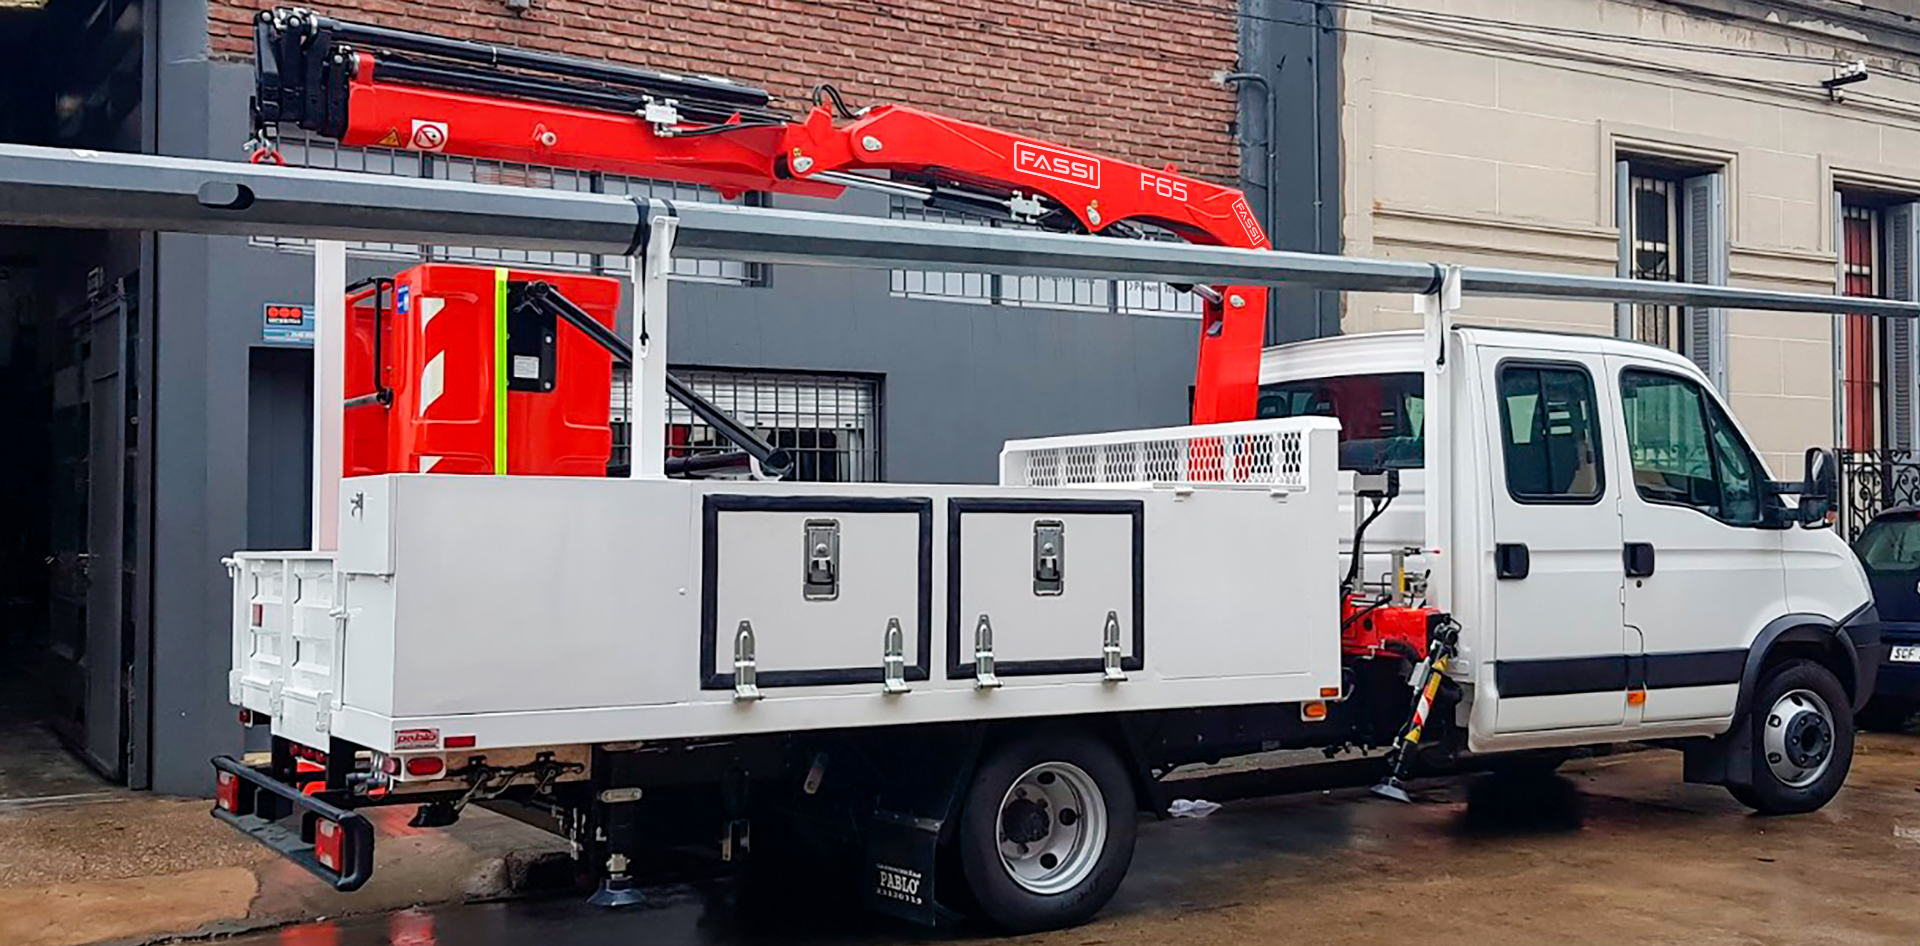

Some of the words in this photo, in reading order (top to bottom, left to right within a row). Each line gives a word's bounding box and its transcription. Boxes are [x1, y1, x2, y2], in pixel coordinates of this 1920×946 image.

[1020, 149, 1094, 181] FASSI
[1140, 172, 1188, 202] F65
[1235, 202, 1262, 242] FASSI
[1894, 647, 1915, 659] SCF
[880, 870, 920, 895] PABLO
